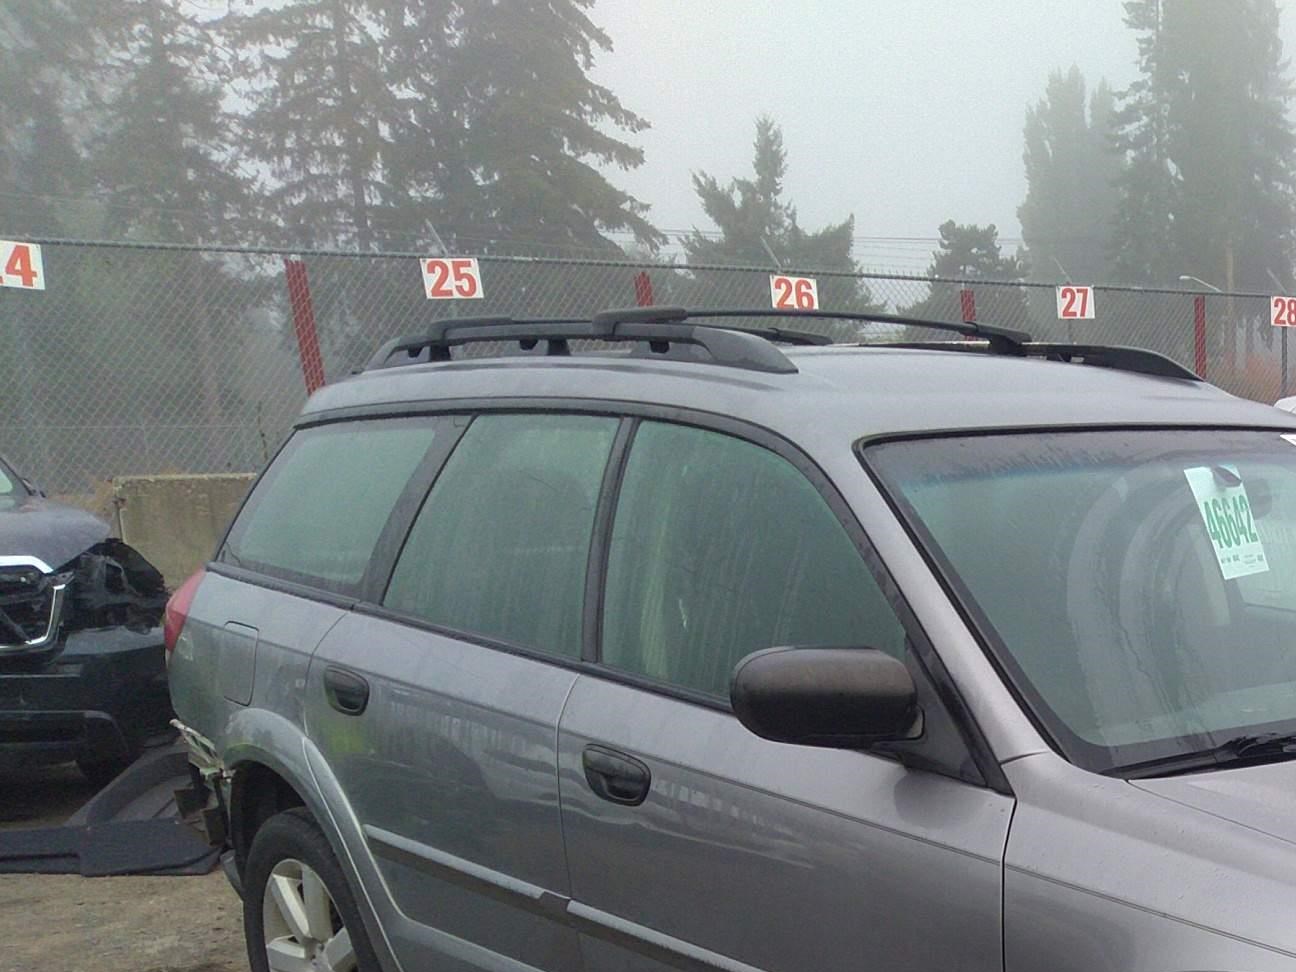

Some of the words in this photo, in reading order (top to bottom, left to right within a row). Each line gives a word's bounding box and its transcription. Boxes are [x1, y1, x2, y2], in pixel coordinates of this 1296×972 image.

[0, 244, 38, 288] 4
[427, 260, 476, 297] 25
[774, 278, 815, 310] 26
[1061, 287, 1090, 319] 27
[1203, 494, 1259, 549] 46642
